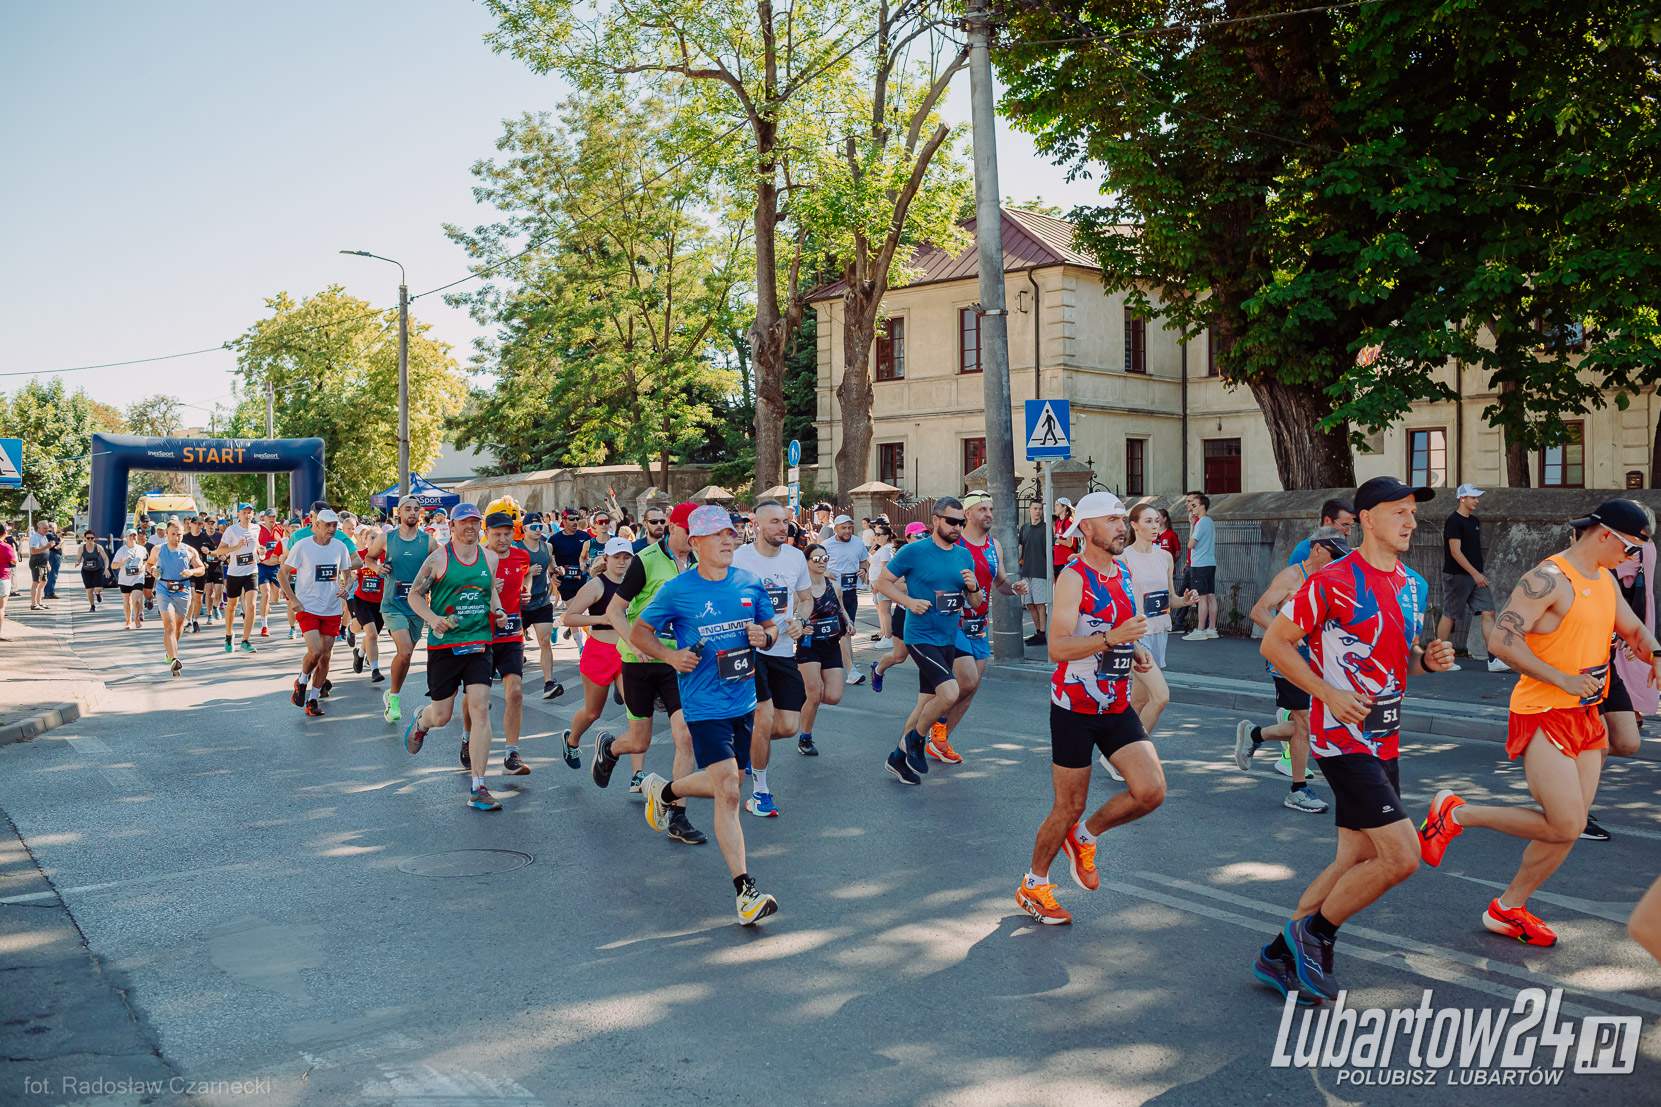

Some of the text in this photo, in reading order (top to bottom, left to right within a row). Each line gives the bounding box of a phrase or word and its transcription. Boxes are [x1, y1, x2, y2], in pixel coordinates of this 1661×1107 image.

[182, 447, 246, 464] START
[459, 592, 480, 601] PGE
[947, 599, 958, 607] 72
[1155, 600, 1160, 608] 3
[821, 625, 832, 634] 63
[970, 624, 979, 632] 52
[734, 658, 749, 671] 64
[1113, 658, 1131, 669] 121
[1383, 708, 1399, 724] 51
